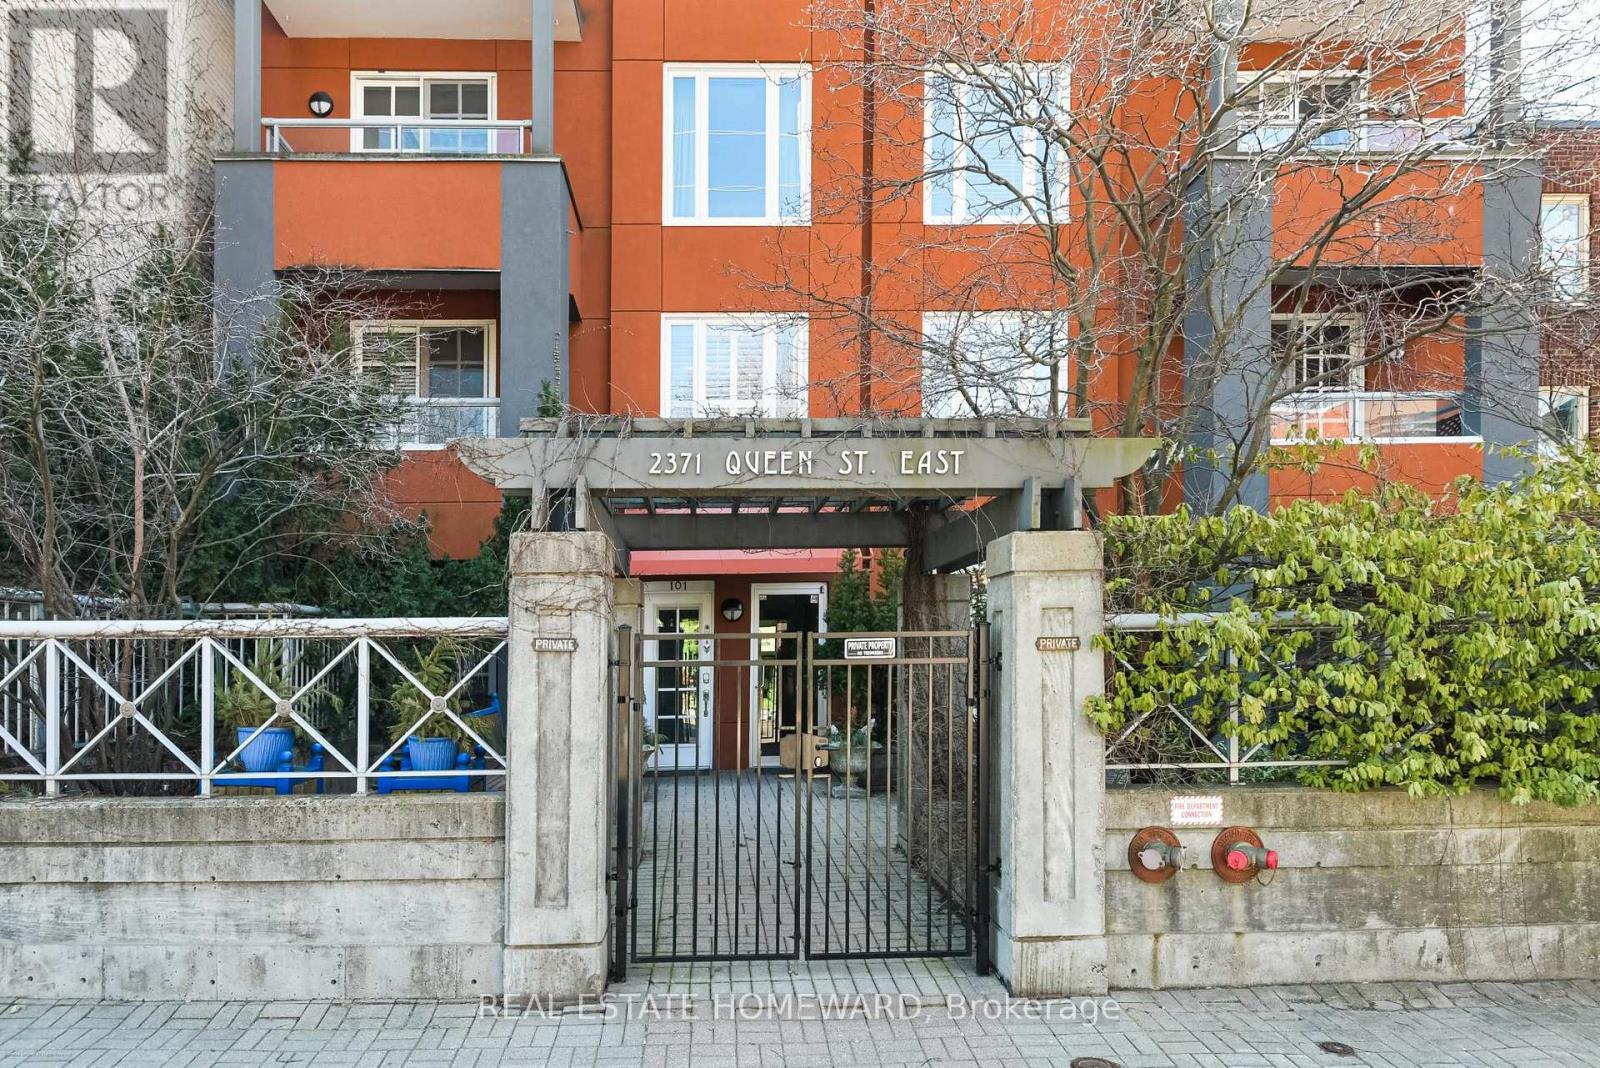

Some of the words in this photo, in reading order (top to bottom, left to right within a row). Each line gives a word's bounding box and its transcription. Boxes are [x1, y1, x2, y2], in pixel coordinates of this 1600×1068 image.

[648, 452, 701, 474] 2371
[725, 450, 813, 475] QUEEN
[838, 450, 877, 475] ST.
[900, 449, 965, 475] EAST
[670, 580, 687, 591] 101
[535, 639, 575, 650] PRIVATE
[847, 641, 867, 650] PRIVATE
[868, 641, 893, 650] PROPERTY
[1039, 638, 1078, 649] PRIVATE
[1187, 802, 1219, 810] DEPARTMENT
